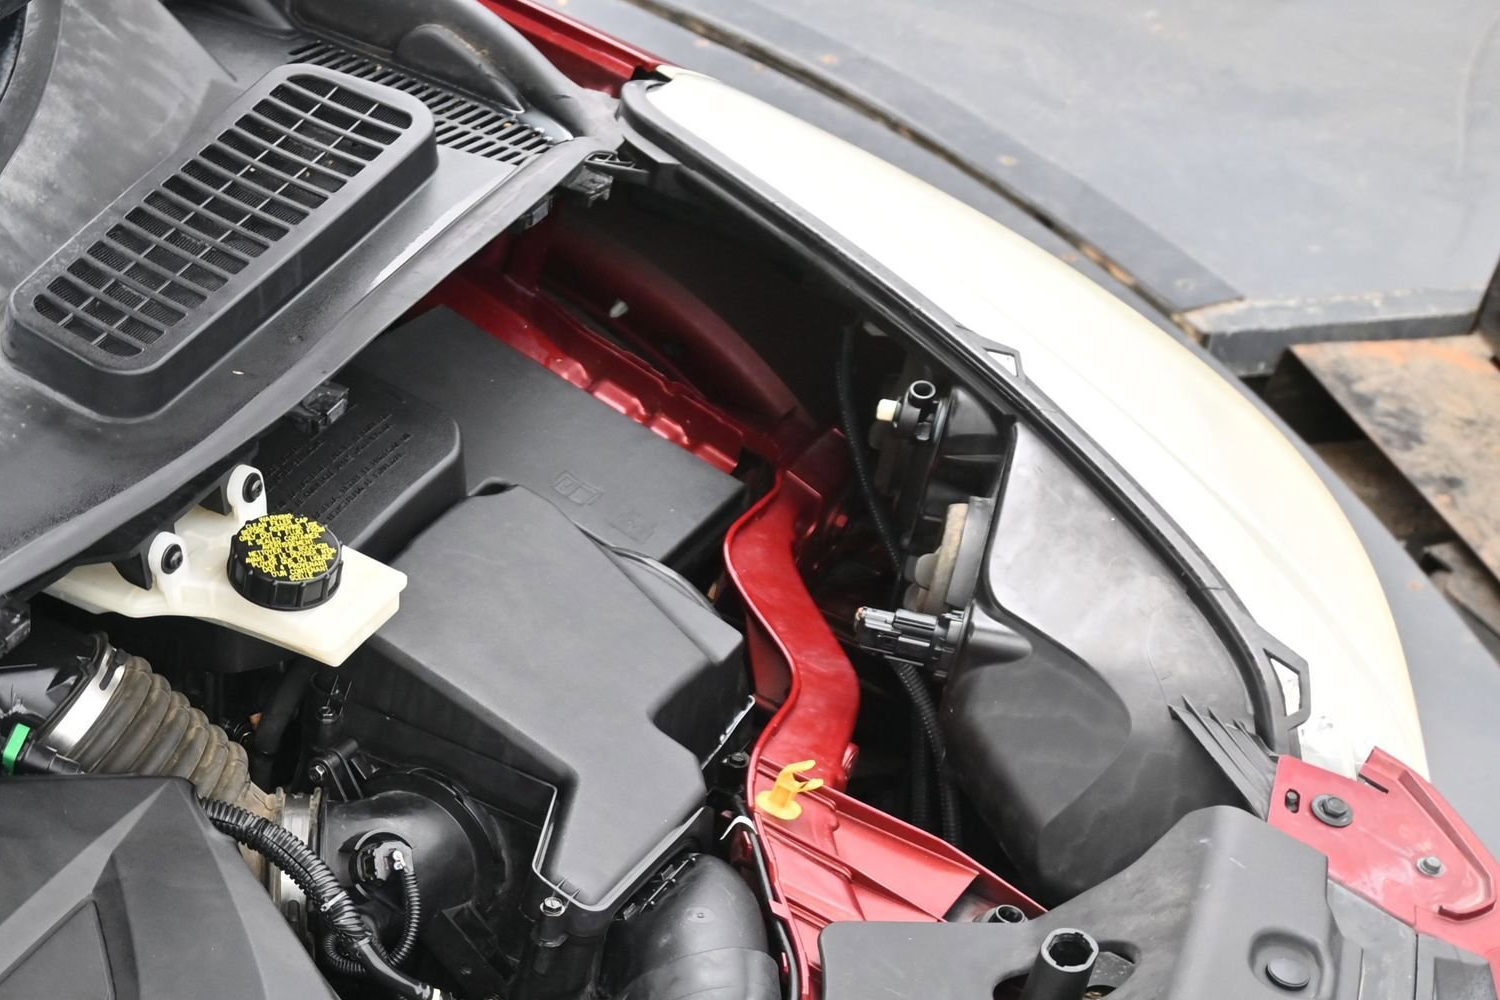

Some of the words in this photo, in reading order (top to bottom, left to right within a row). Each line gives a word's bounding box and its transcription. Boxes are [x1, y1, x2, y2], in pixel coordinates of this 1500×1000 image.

[270, 518, 292, 527] FILLER
[295, 517, 308, 525] CAP
[284, 531, 321, 542] CONTAINER
[290, 563, 329, 576] CONTENANT
